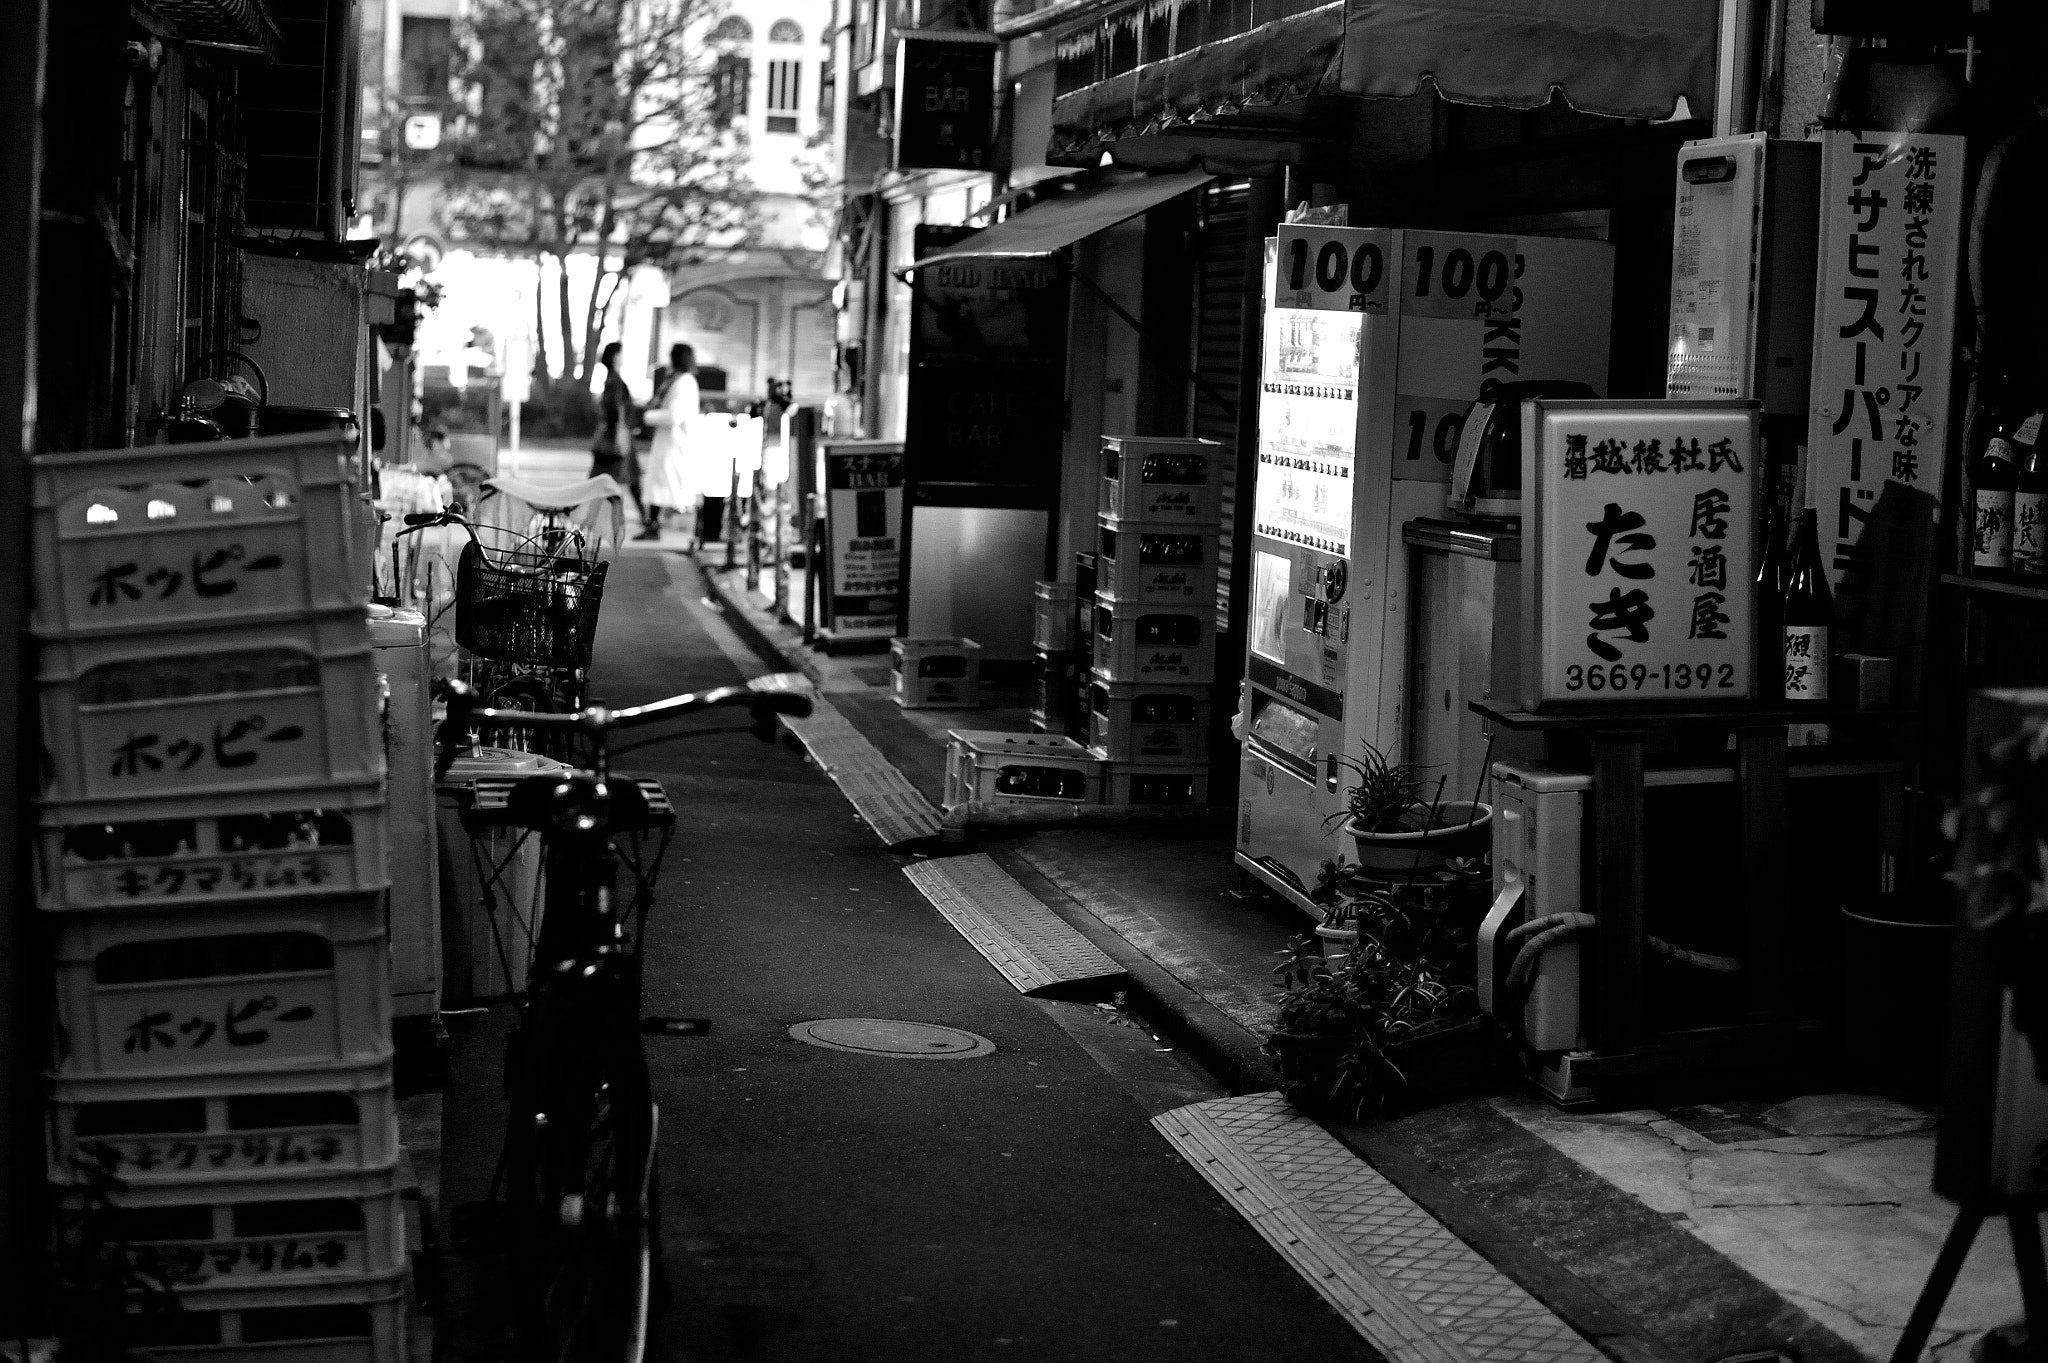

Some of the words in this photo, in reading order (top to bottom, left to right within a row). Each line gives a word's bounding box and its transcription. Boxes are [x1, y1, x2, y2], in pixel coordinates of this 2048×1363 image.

[924, 85, 970, 113] BAR
[1289, 238, 1384, 294] 100
[1415, 245, 1509, 300] 100
[947, 391, 1021, 417] CAFE
[946, 423, 1002, 448] BAR
[1564, 434, 1588, 480] 清酒
[1589, 436, 1745, 475] 越後杜氏
[848, 472, 889, 488] BAR
[1156, 491, 1190, 504] Asahi
[90, 543, 282, 605] ホッピー
[1152, 572, 1187, 584] Asahi
[1585, 502, 1657, 662] たき
[1687, 487, 1732, 640] 居酒屋
[1149, 652, 1182, 664] Asahi
[1565, 663, 1735, 691] 3669-1392
[111, 715, 304, 777] ホッピー
[124, 994, 314, 1053] ホッピー
